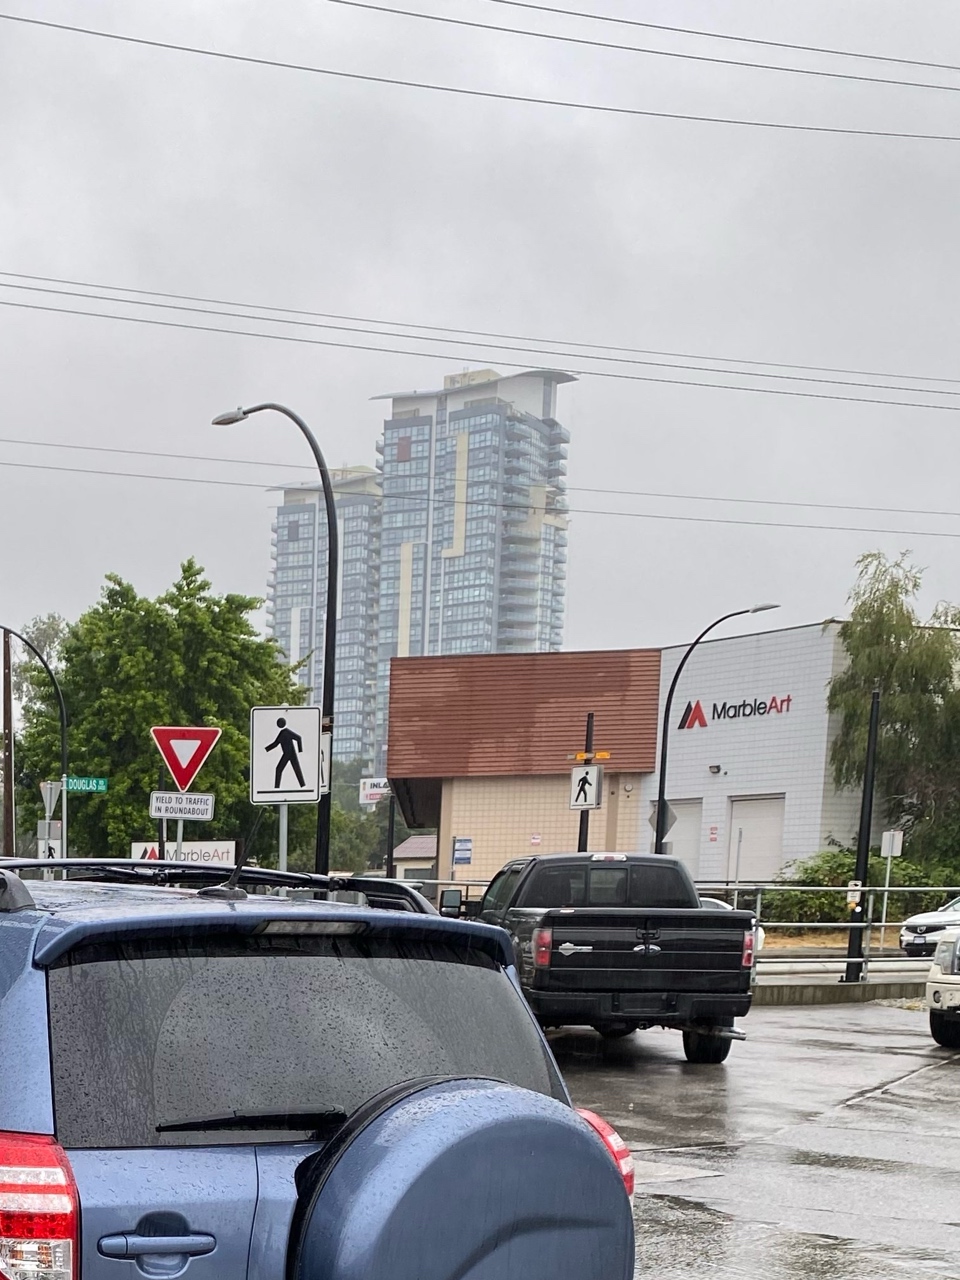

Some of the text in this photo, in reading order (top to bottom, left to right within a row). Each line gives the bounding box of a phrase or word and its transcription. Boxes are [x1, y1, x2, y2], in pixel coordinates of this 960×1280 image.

[712, 694, 792, 720] MarbleArt
[68, 778, 97, 790] DOUGLAS
[155, 796, 210, 806] YIELD TO TRAFFIC
[154, 806, 209, 816] IN ROUNDABOUT
